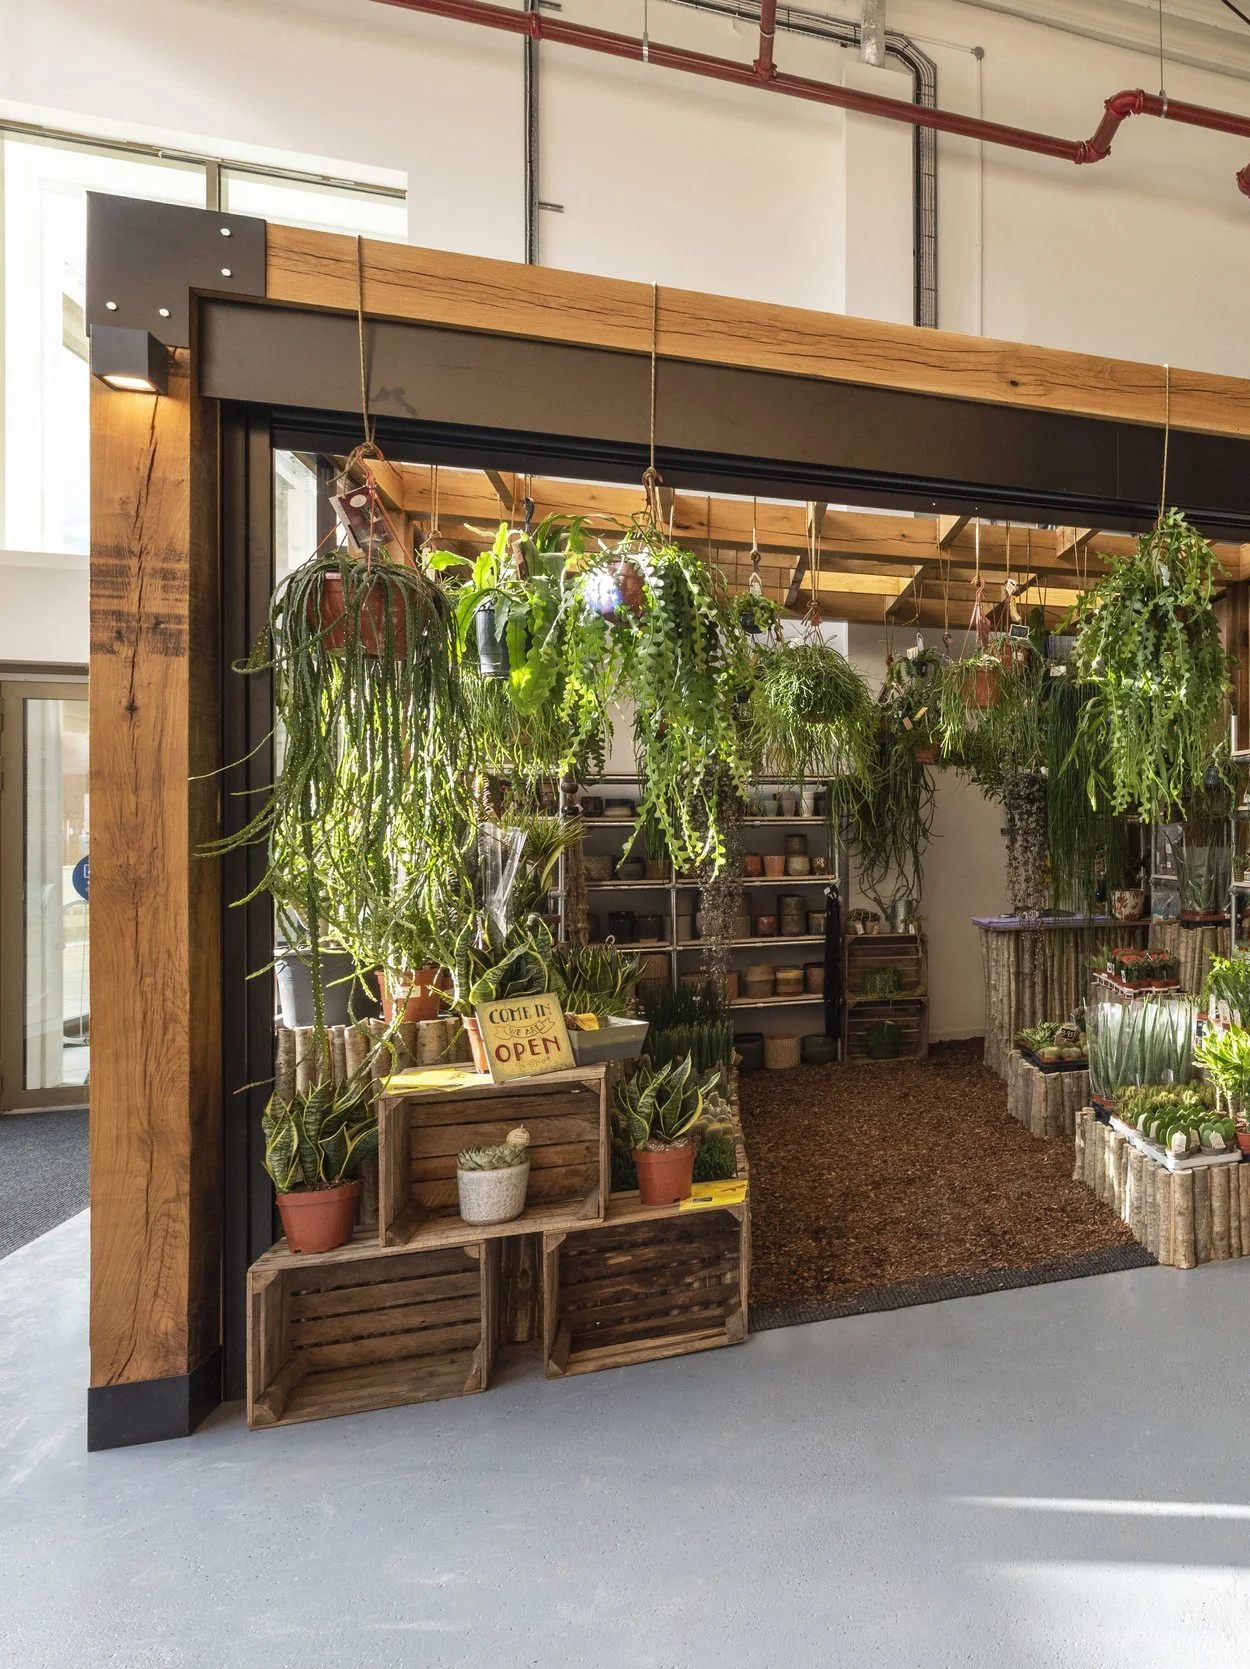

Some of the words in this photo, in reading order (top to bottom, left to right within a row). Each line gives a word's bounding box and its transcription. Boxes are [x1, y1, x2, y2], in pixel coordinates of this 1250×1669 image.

[489, 1006, 531, 1025] COME
[534, 1003, 552, 1018] IN
[509, 1027, 521, 1036] WE
[525, 1022, 541, 1036] ARE
[495, 1035, 561, 1063] OPEN
